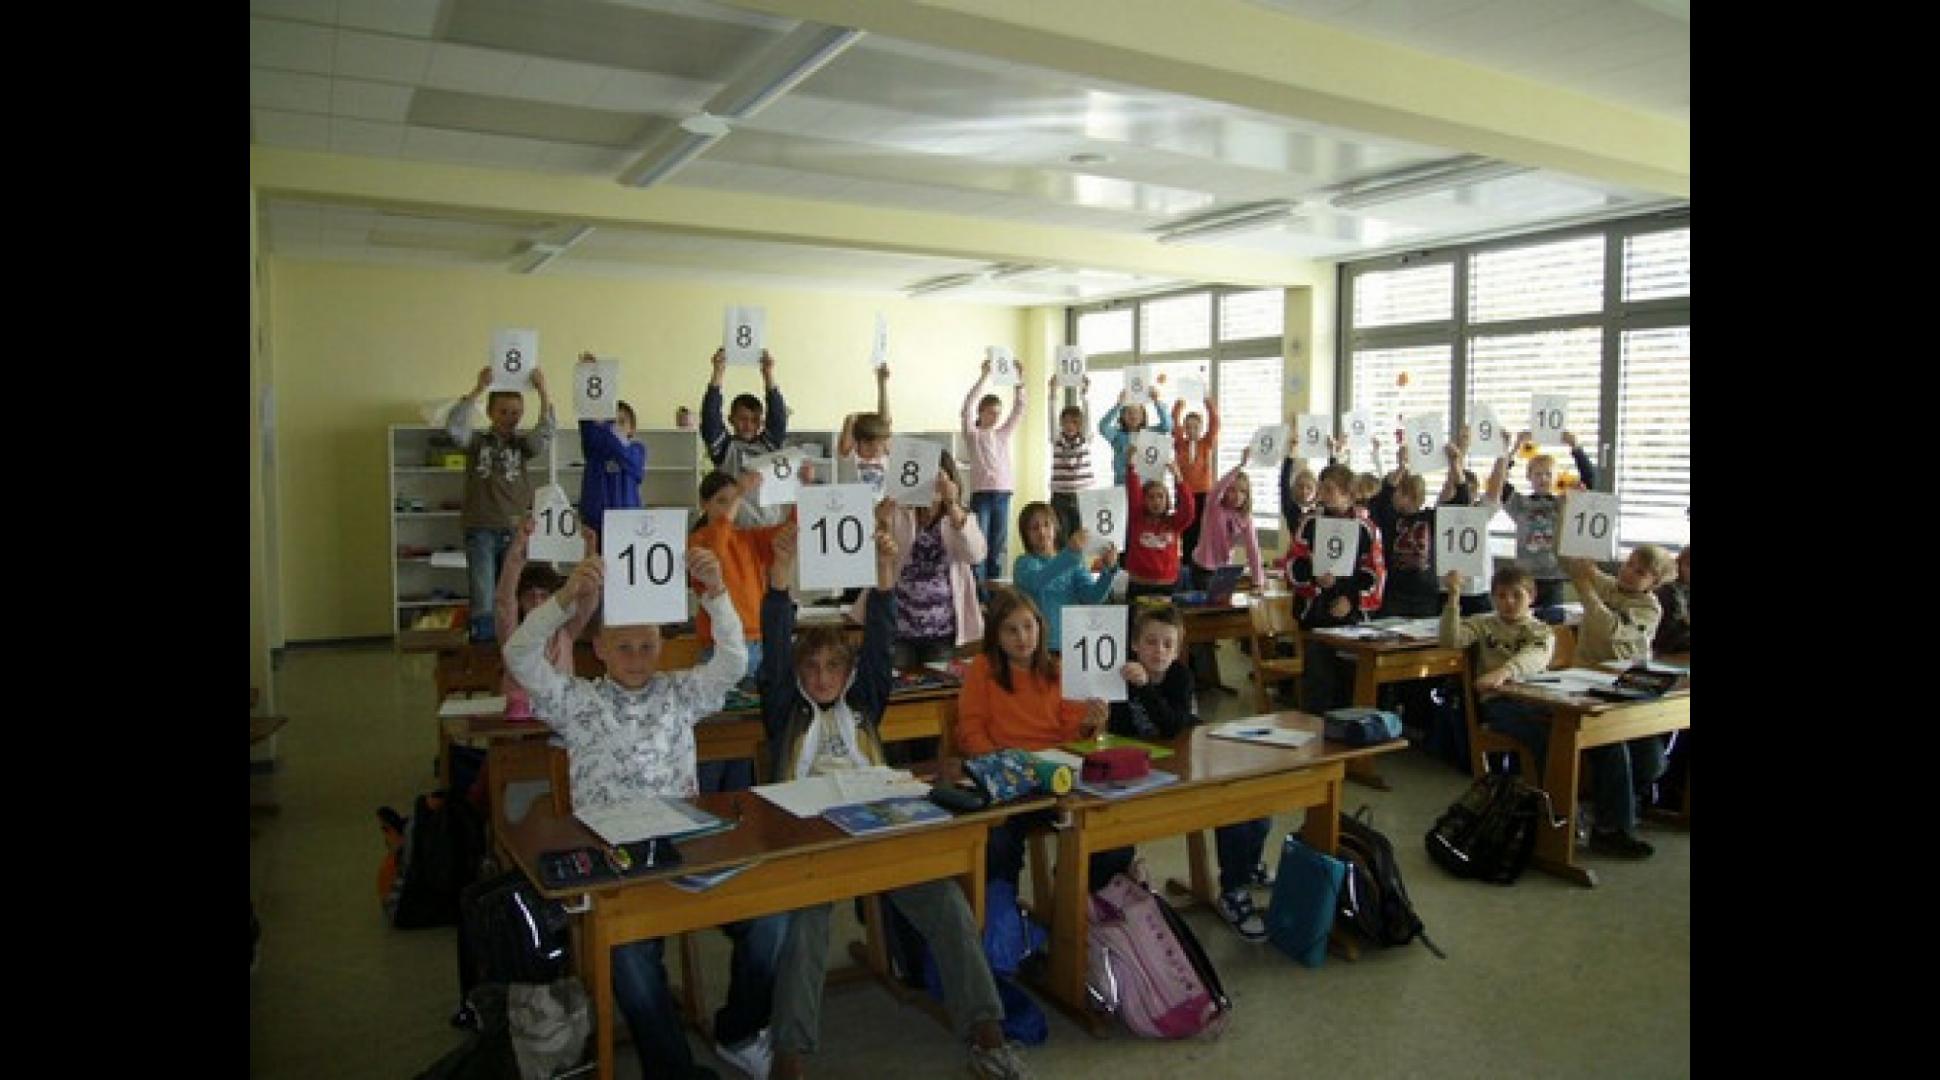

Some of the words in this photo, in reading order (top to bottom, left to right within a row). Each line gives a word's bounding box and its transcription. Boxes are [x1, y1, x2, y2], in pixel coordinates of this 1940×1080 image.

[736, 325, 751, 348] 8
[506, 349, 521, 372] 8
[998, 358, 1009, 374] 8
[1062, 358, 1081, 375] 10
[586, 376, 602, 398] 8
[1480, 420, 1491, 441] 9
[1537, 408, 1562, 430] 10
[1260, 435, 1273, 454] 9
[1306, 426, 1320, 444] 9
[1418, 432, 1433, 455] 9
[1145, 446, 1158, 464] 9
[771, 456, 792, 479] 8
[900, 461, 919, 487] 8
[540, 508, 576, 537] 10
[1096, 509, 1114, 535] 8
[1576, 512, 1607, 539] 10
[811, 515, 864, 554] 10
[1443, 527, 1477, 554] 10
[1327, 536, 1344, 559] 9
[618, 543, 674, 585] 10
[1073, 634, 1117, 672] 10
